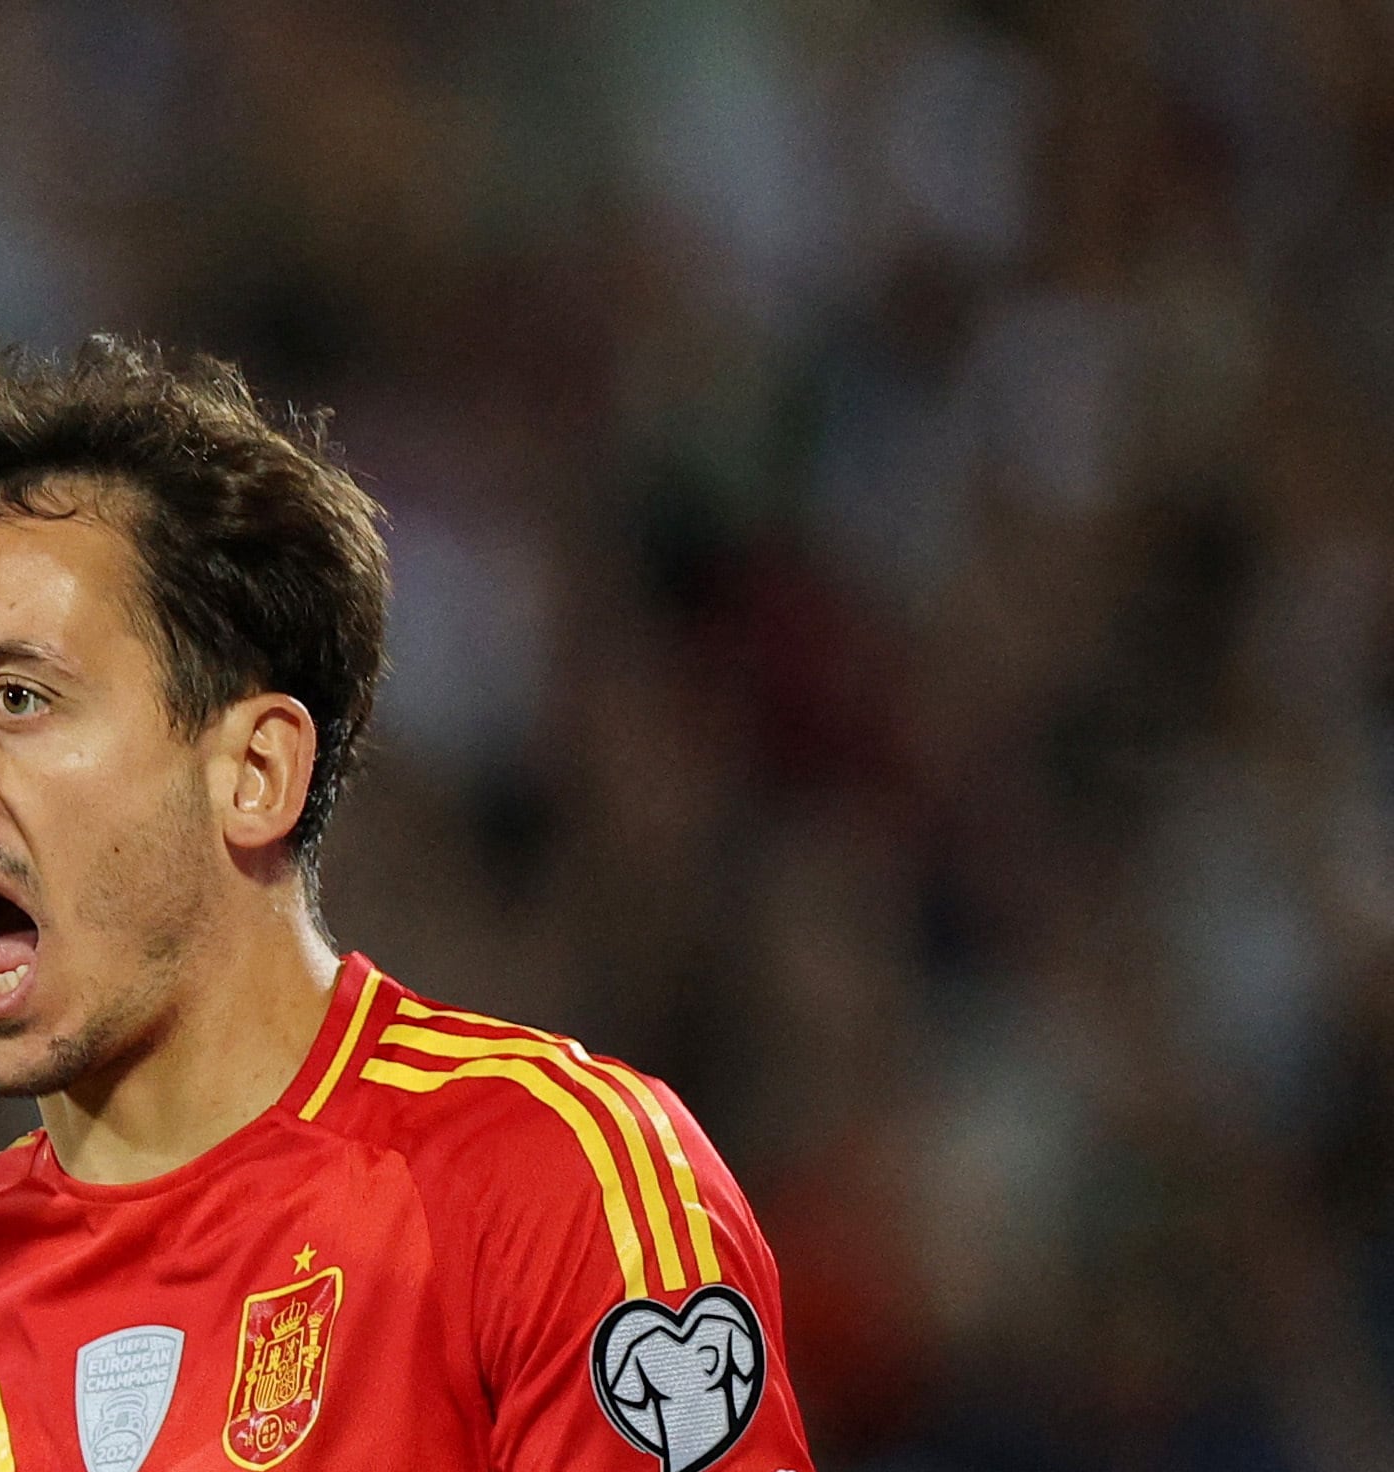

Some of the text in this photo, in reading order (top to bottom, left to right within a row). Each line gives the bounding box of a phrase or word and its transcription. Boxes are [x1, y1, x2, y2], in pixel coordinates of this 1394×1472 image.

[117, 1338, 149, 1354] UEFA
[87, 1350, 171, 1377] EUROPEAN
[86, 1366, 170, 1392] CHAMPIONS
[96, 1445, 138, 1464] 2024
